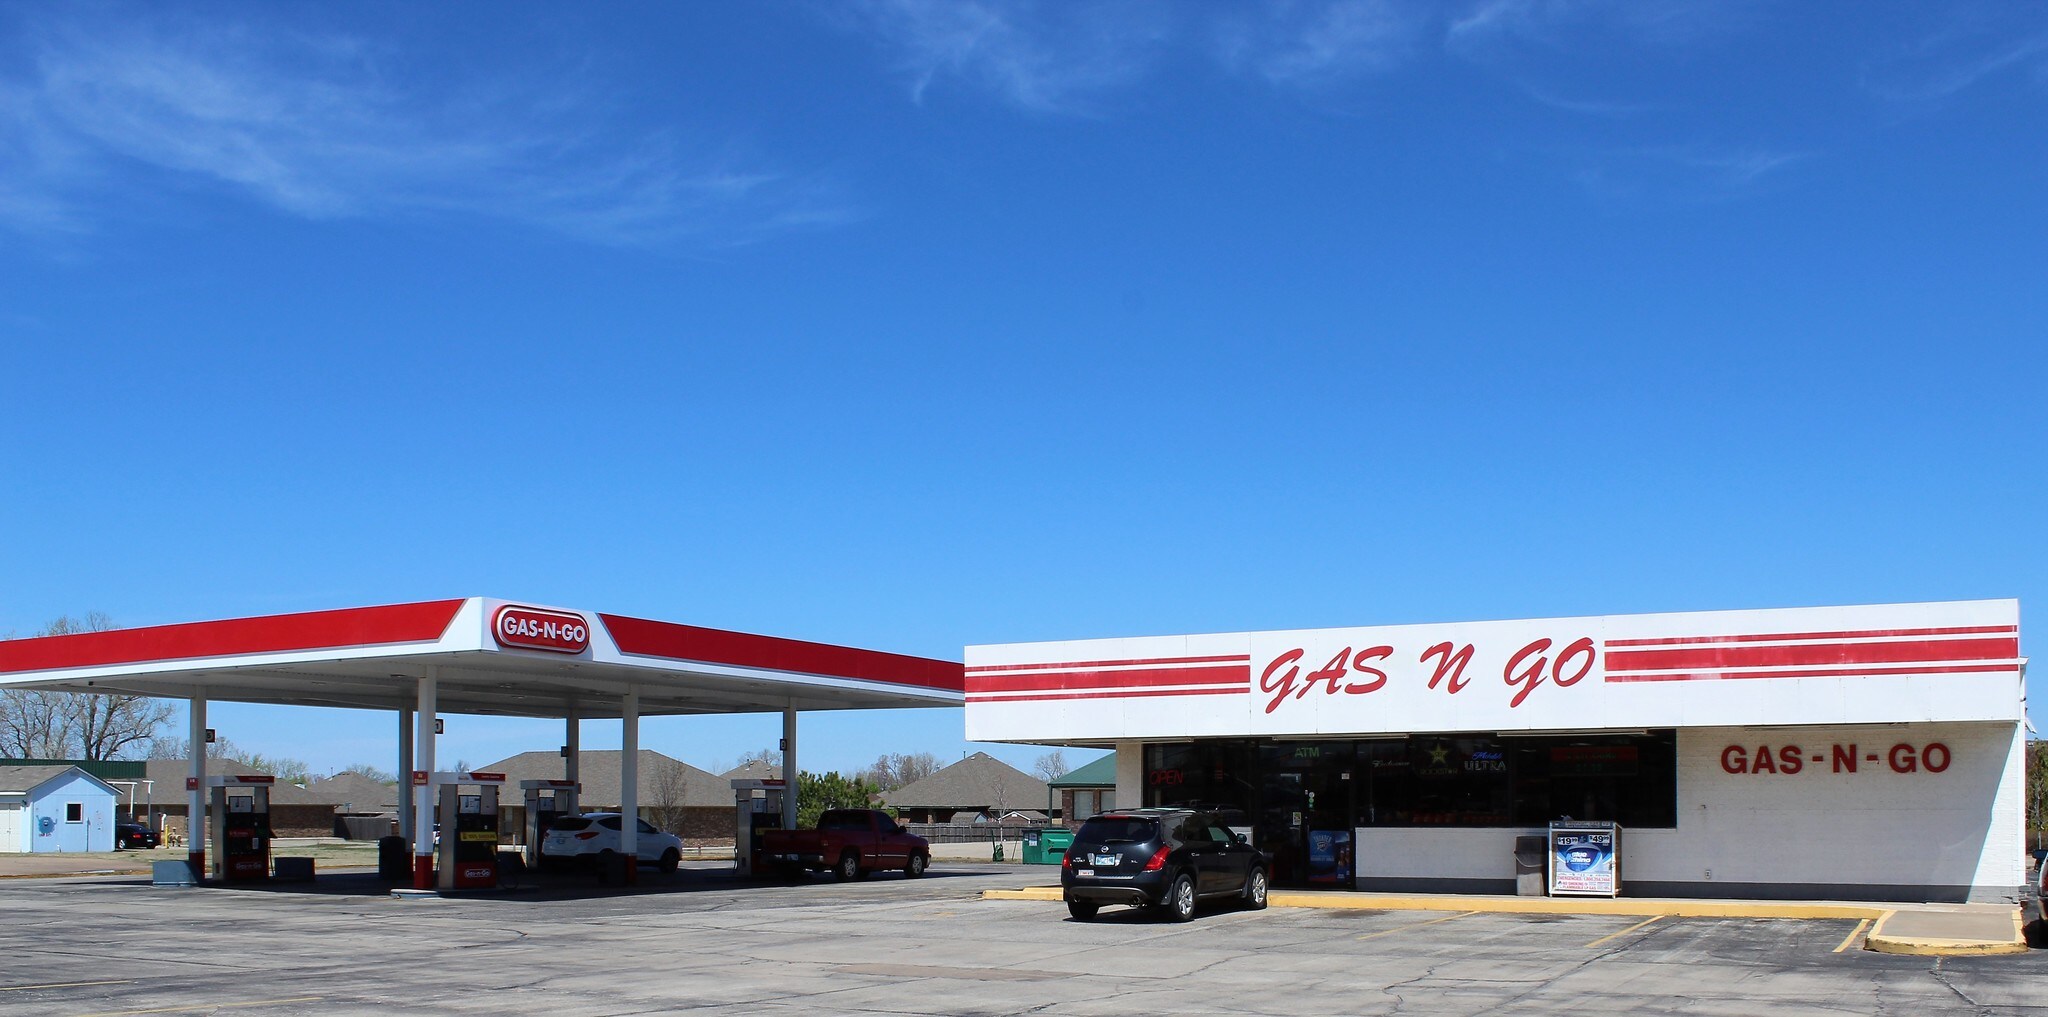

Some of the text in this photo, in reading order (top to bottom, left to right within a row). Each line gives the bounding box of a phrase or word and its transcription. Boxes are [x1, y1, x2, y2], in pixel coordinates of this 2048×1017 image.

[504, 616, 586, 643] GAS-N-GO
[1260, 637, 1596, 714] GAS N GO
[1295, 747, 1320, 758] ATM
[1464, 761, 1507, 771] ULTRA
[1151, 767, 1185, 785] OPEN
